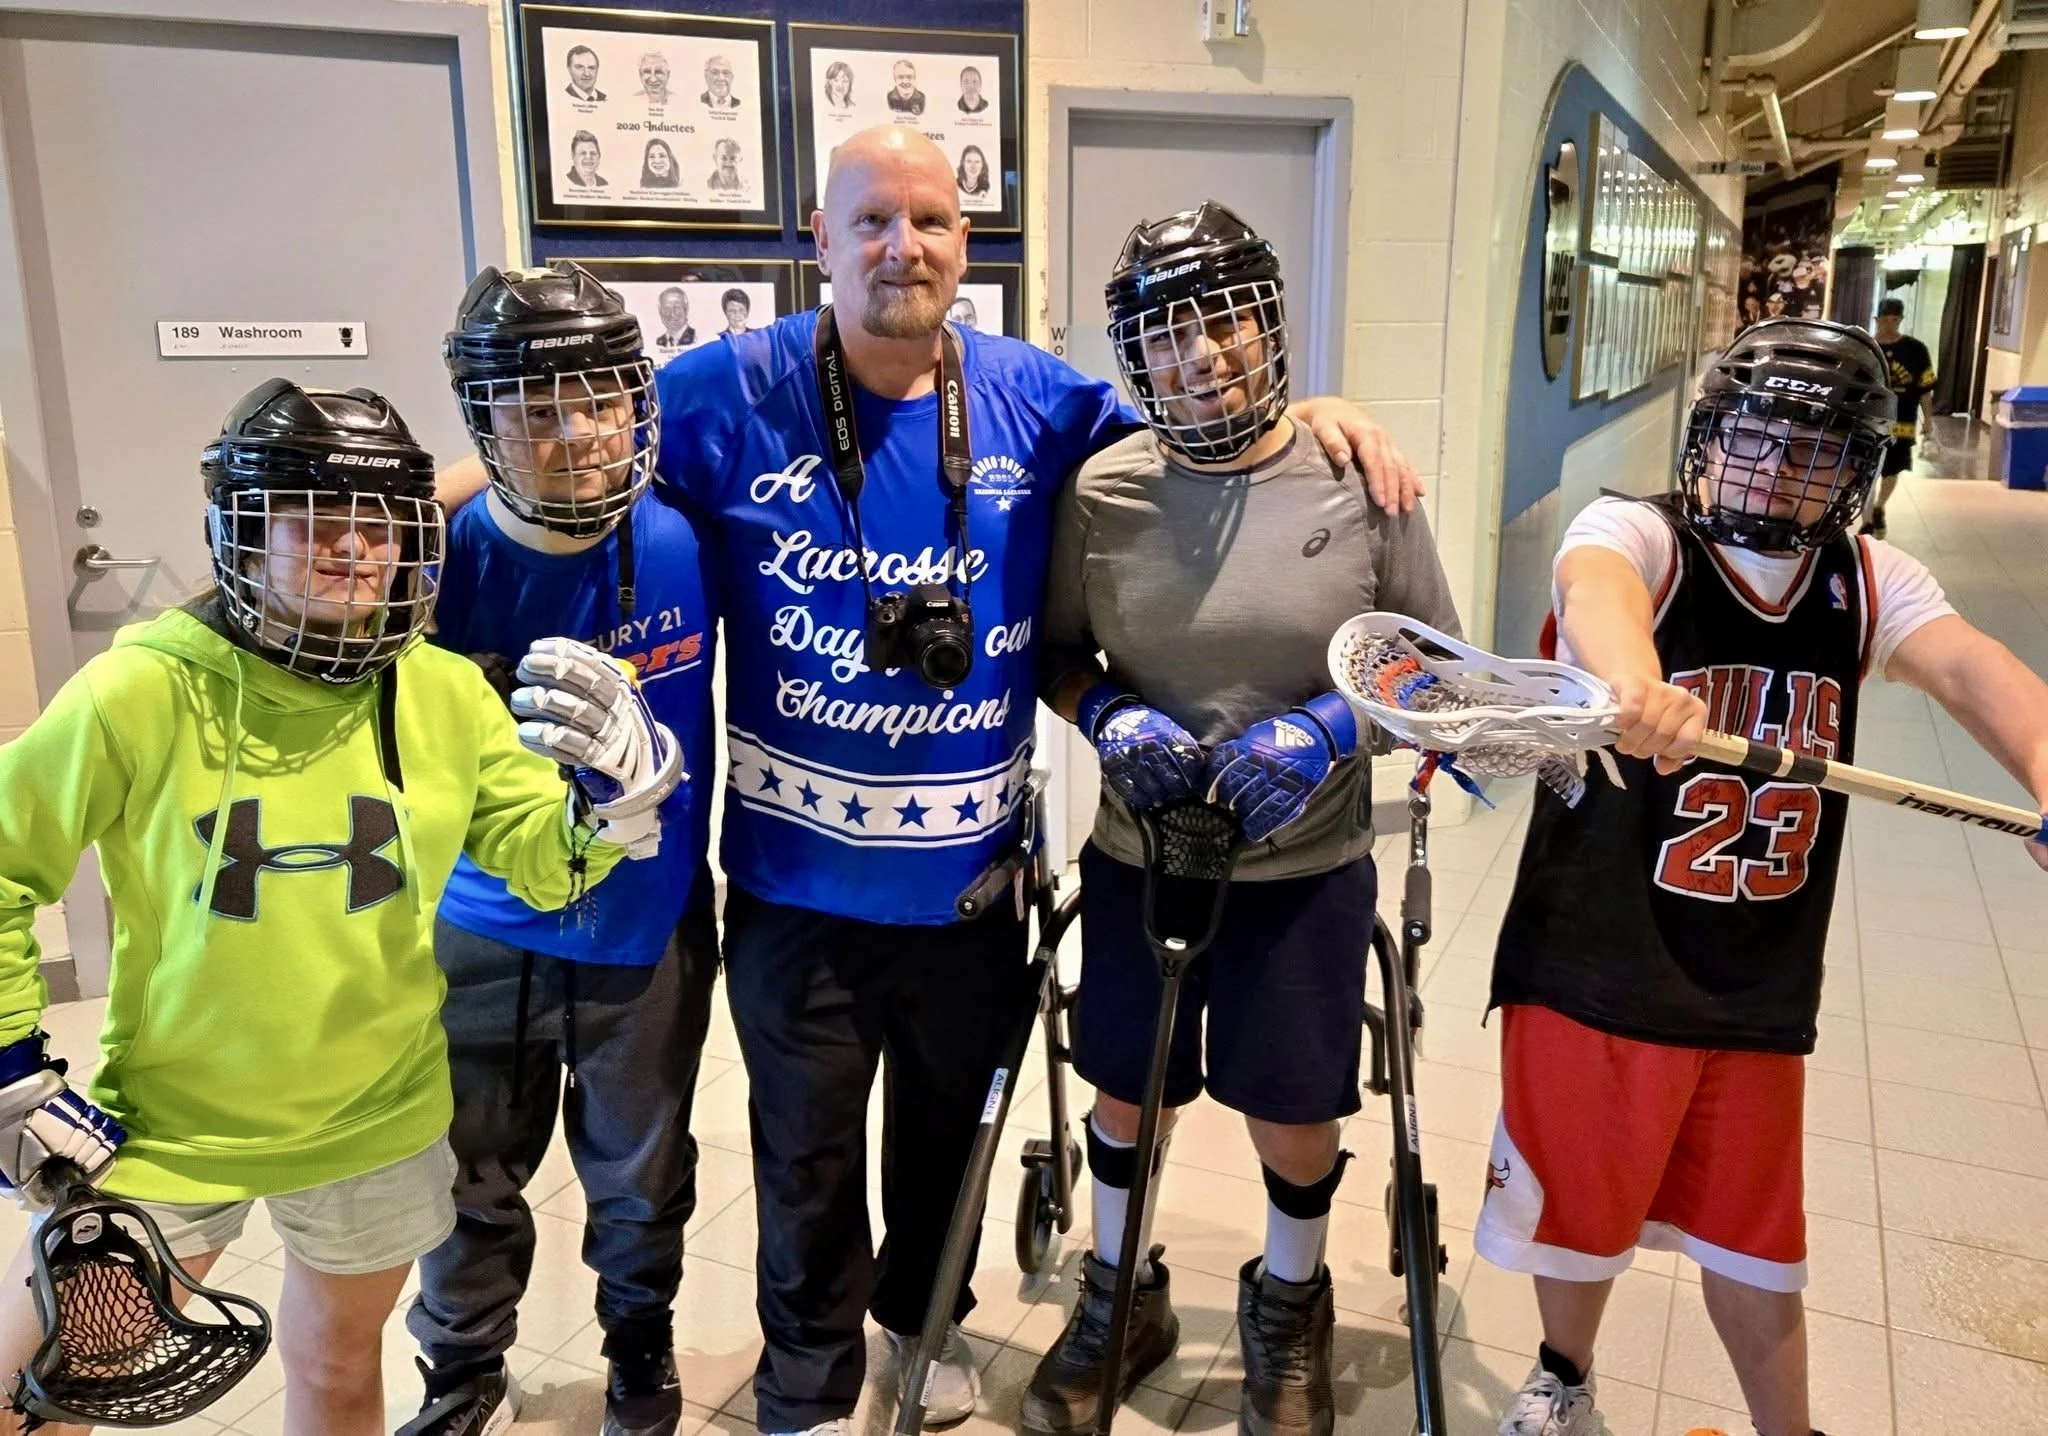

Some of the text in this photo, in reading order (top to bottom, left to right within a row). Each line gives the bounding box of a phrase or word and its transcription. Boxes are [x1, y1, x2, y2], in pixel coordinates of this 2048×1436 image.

[616, 120, 696, 134] 2020 Inductees
[1145, 260, 1202, 286] BAUER
[171, 325, 303, 339] 189 Washroom
[529, 333, 594, 350] BAUER
[823, 350, 850, 451] EOS DIGITAL
[1764, 376, 1833, 396] CCM
[946, 379, 961, 438] Canon
[326, 453, 400, 469] BAUER
[750, 454, 823, 504] A
[758, 529, 990, 595] Lacrosse
[658, 606, 683, 633] 21
[769, 604, 871, 684] Day
[774, 669, 1012, 749] Champions
[1272, 719, 1317, 747] adidas
[1896, 792, 2041, 838] harrow
[1653, 772, 1822, 903] 23
